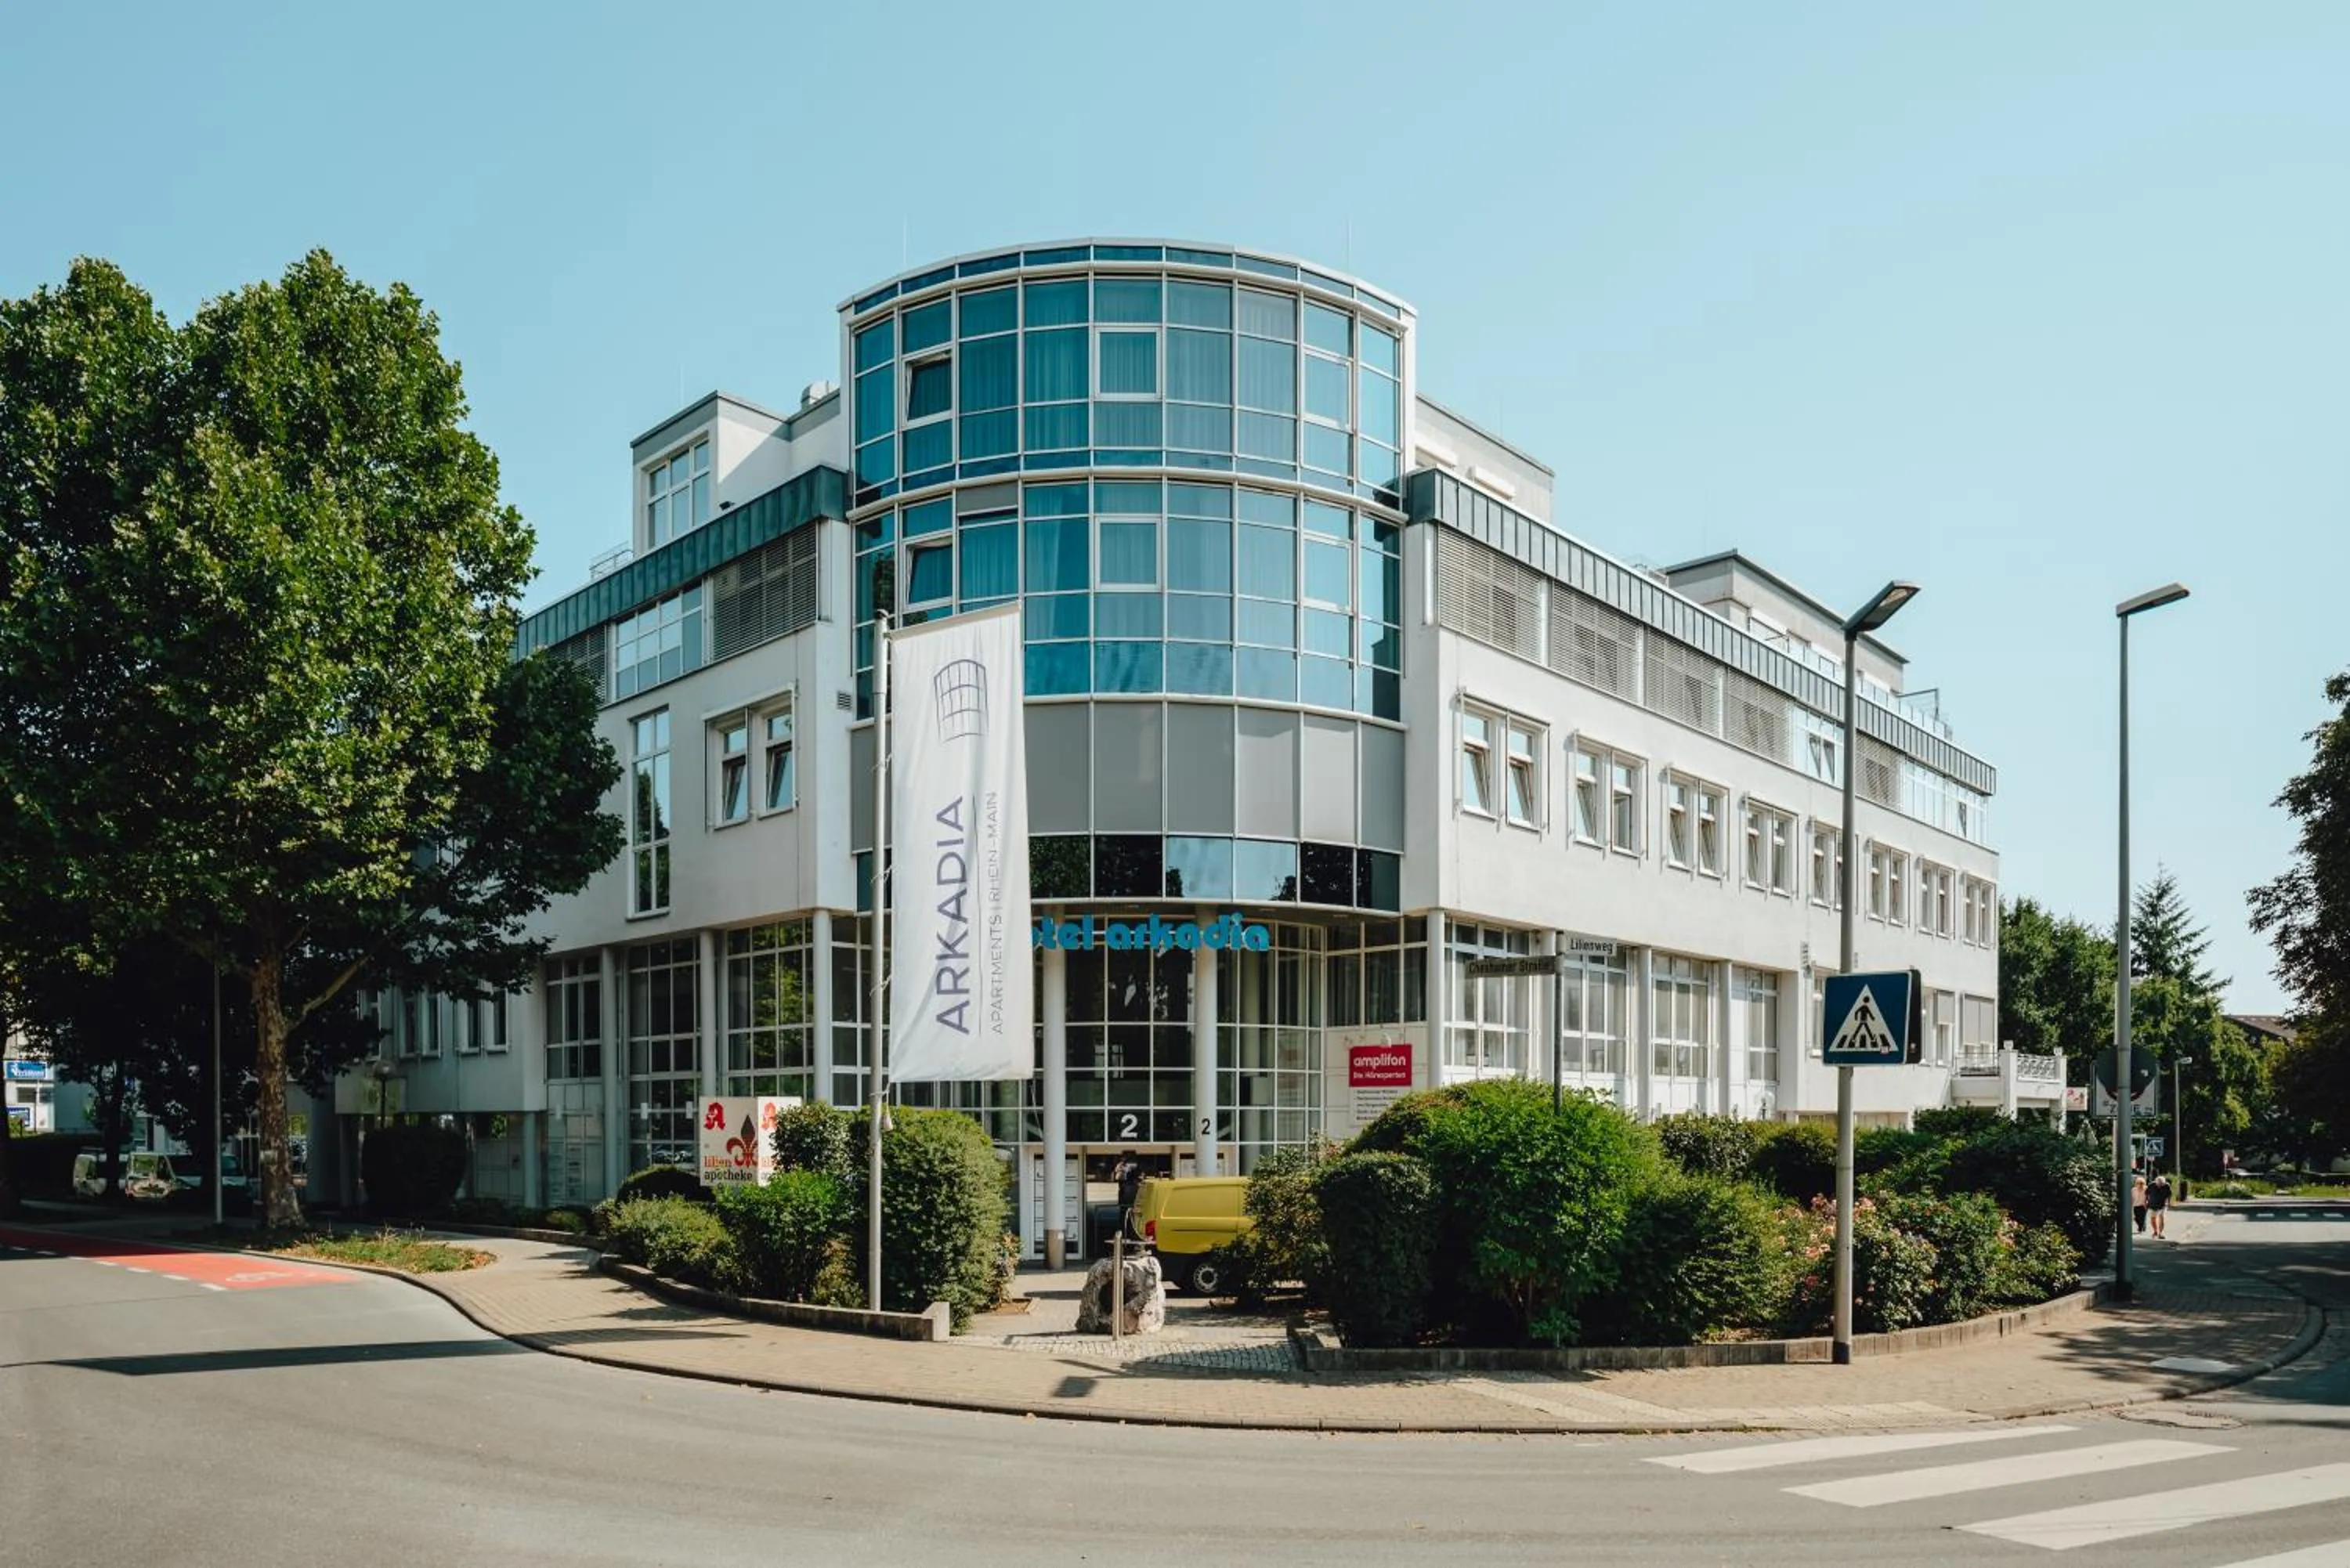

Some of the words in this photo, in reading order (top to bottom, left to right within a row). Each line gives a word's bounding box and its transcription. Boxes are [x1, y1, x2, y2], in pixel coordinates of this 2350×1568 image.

[986, 792, 1000, 902] RHEIN-MAIN
[936, 795, 970, 1035] ARKADIA
[1104, 912, 1270, 952] arkadia
[989, 914, 1003, 1035] APARTMENTS
[1353, 1053, 1406, 1070] amplifon
[1121, 1114, 1138, 1138] 2
[1202, 1118, 1211, 1135] 2
[704, 1169, 753, 1182] apotheke
